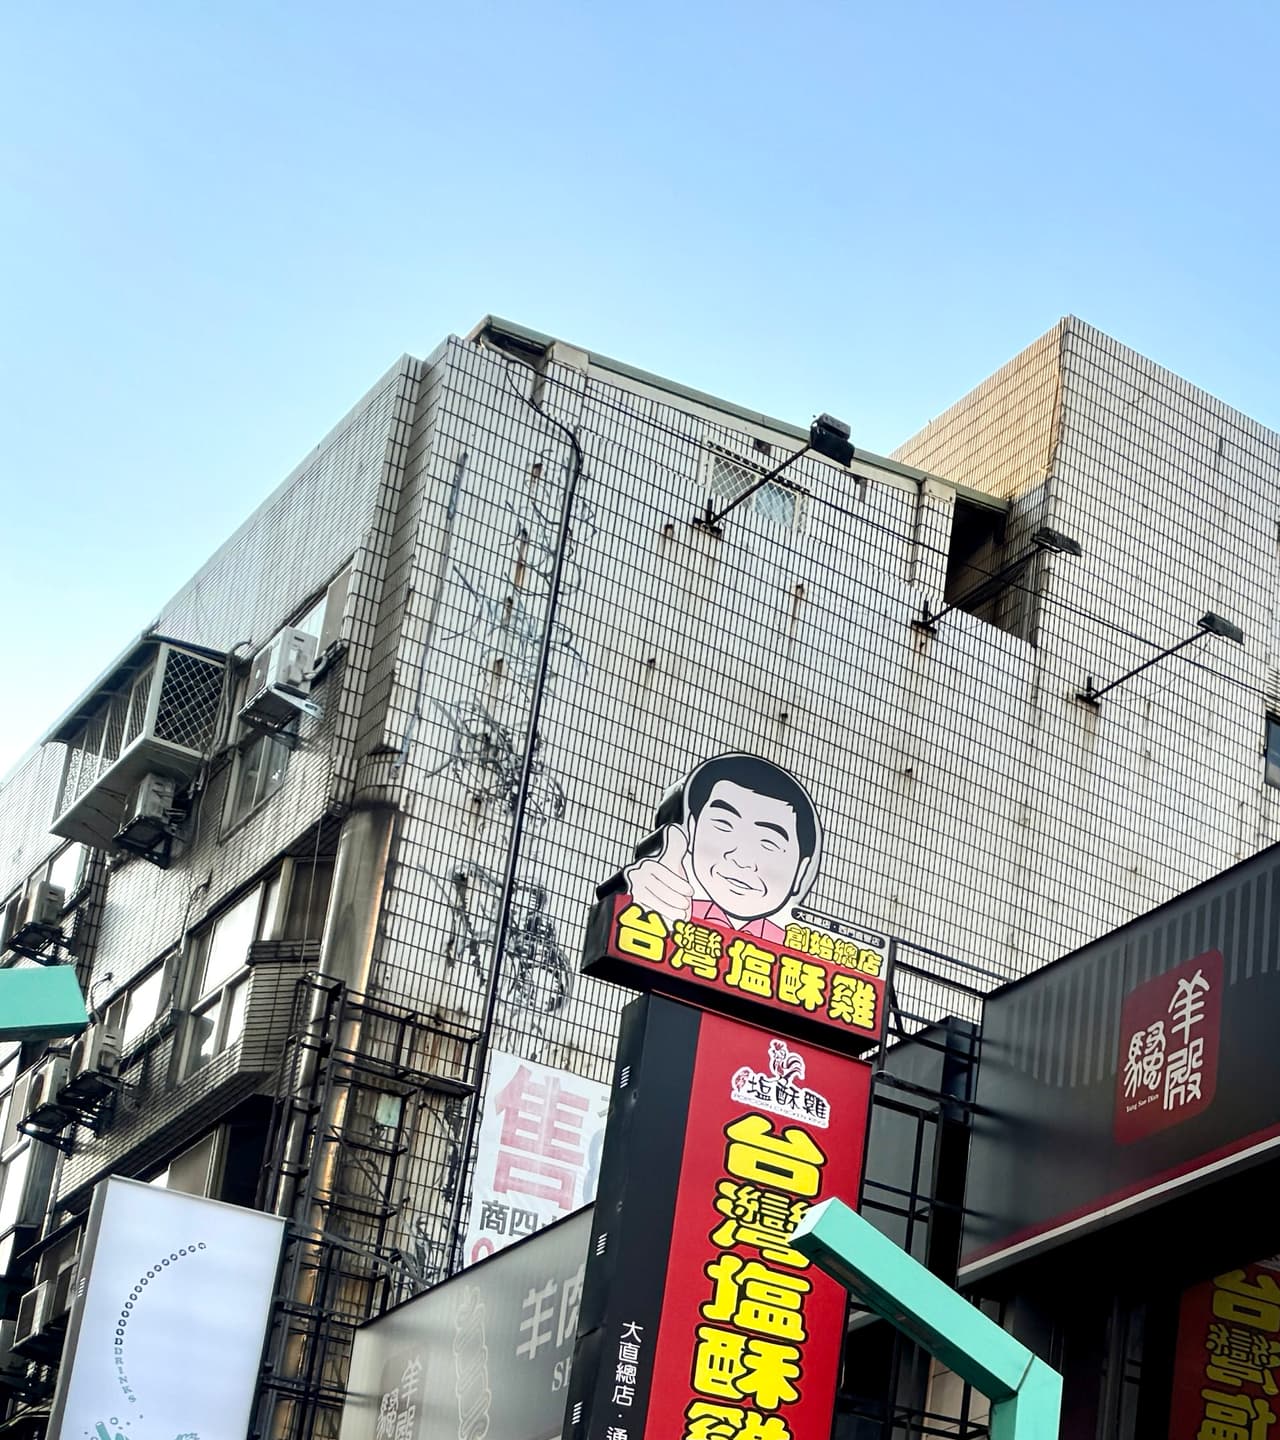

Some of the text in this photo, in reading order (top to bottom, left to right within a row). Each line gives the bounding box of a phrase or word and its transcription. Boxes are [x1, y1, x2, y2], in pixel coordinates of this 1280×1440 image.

[616, 906, 878, 1031] 台灣塩酥雞
[784, 923, 884, 977] 創始總店
[494, 1065, 590, 1211] 售
[611, 1321, 644, 1407] 大直總店
